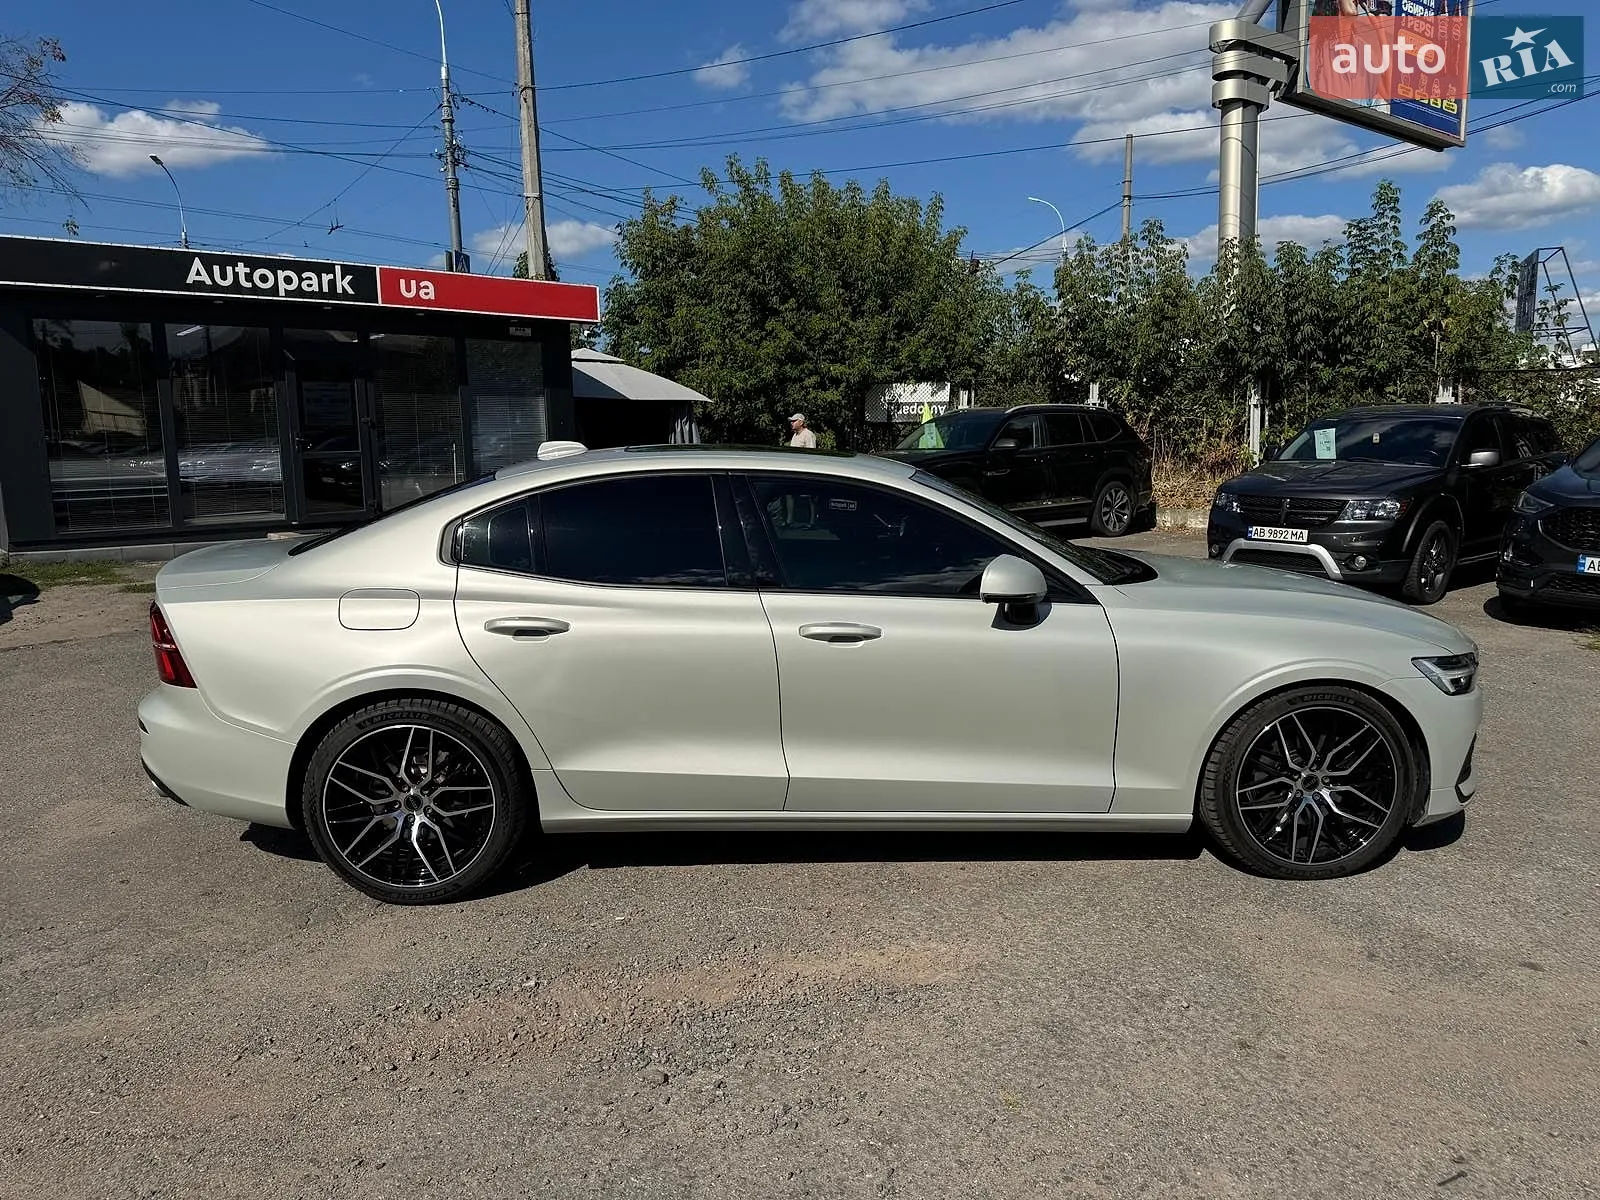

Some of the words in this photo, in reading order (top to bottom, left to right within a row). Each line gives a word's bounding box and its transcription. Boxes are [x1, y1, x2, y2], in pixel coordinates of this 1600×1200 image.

[1407, 16, 1435, 39] PEPSI
[186, 256, 355, 296] Autopark
[399, 278, 435, 300] ua
[1253, 527, 1266, 538] AB
[1267, 528, 1289, 540] 9892
[1290, 529, 1305, 541] MA
